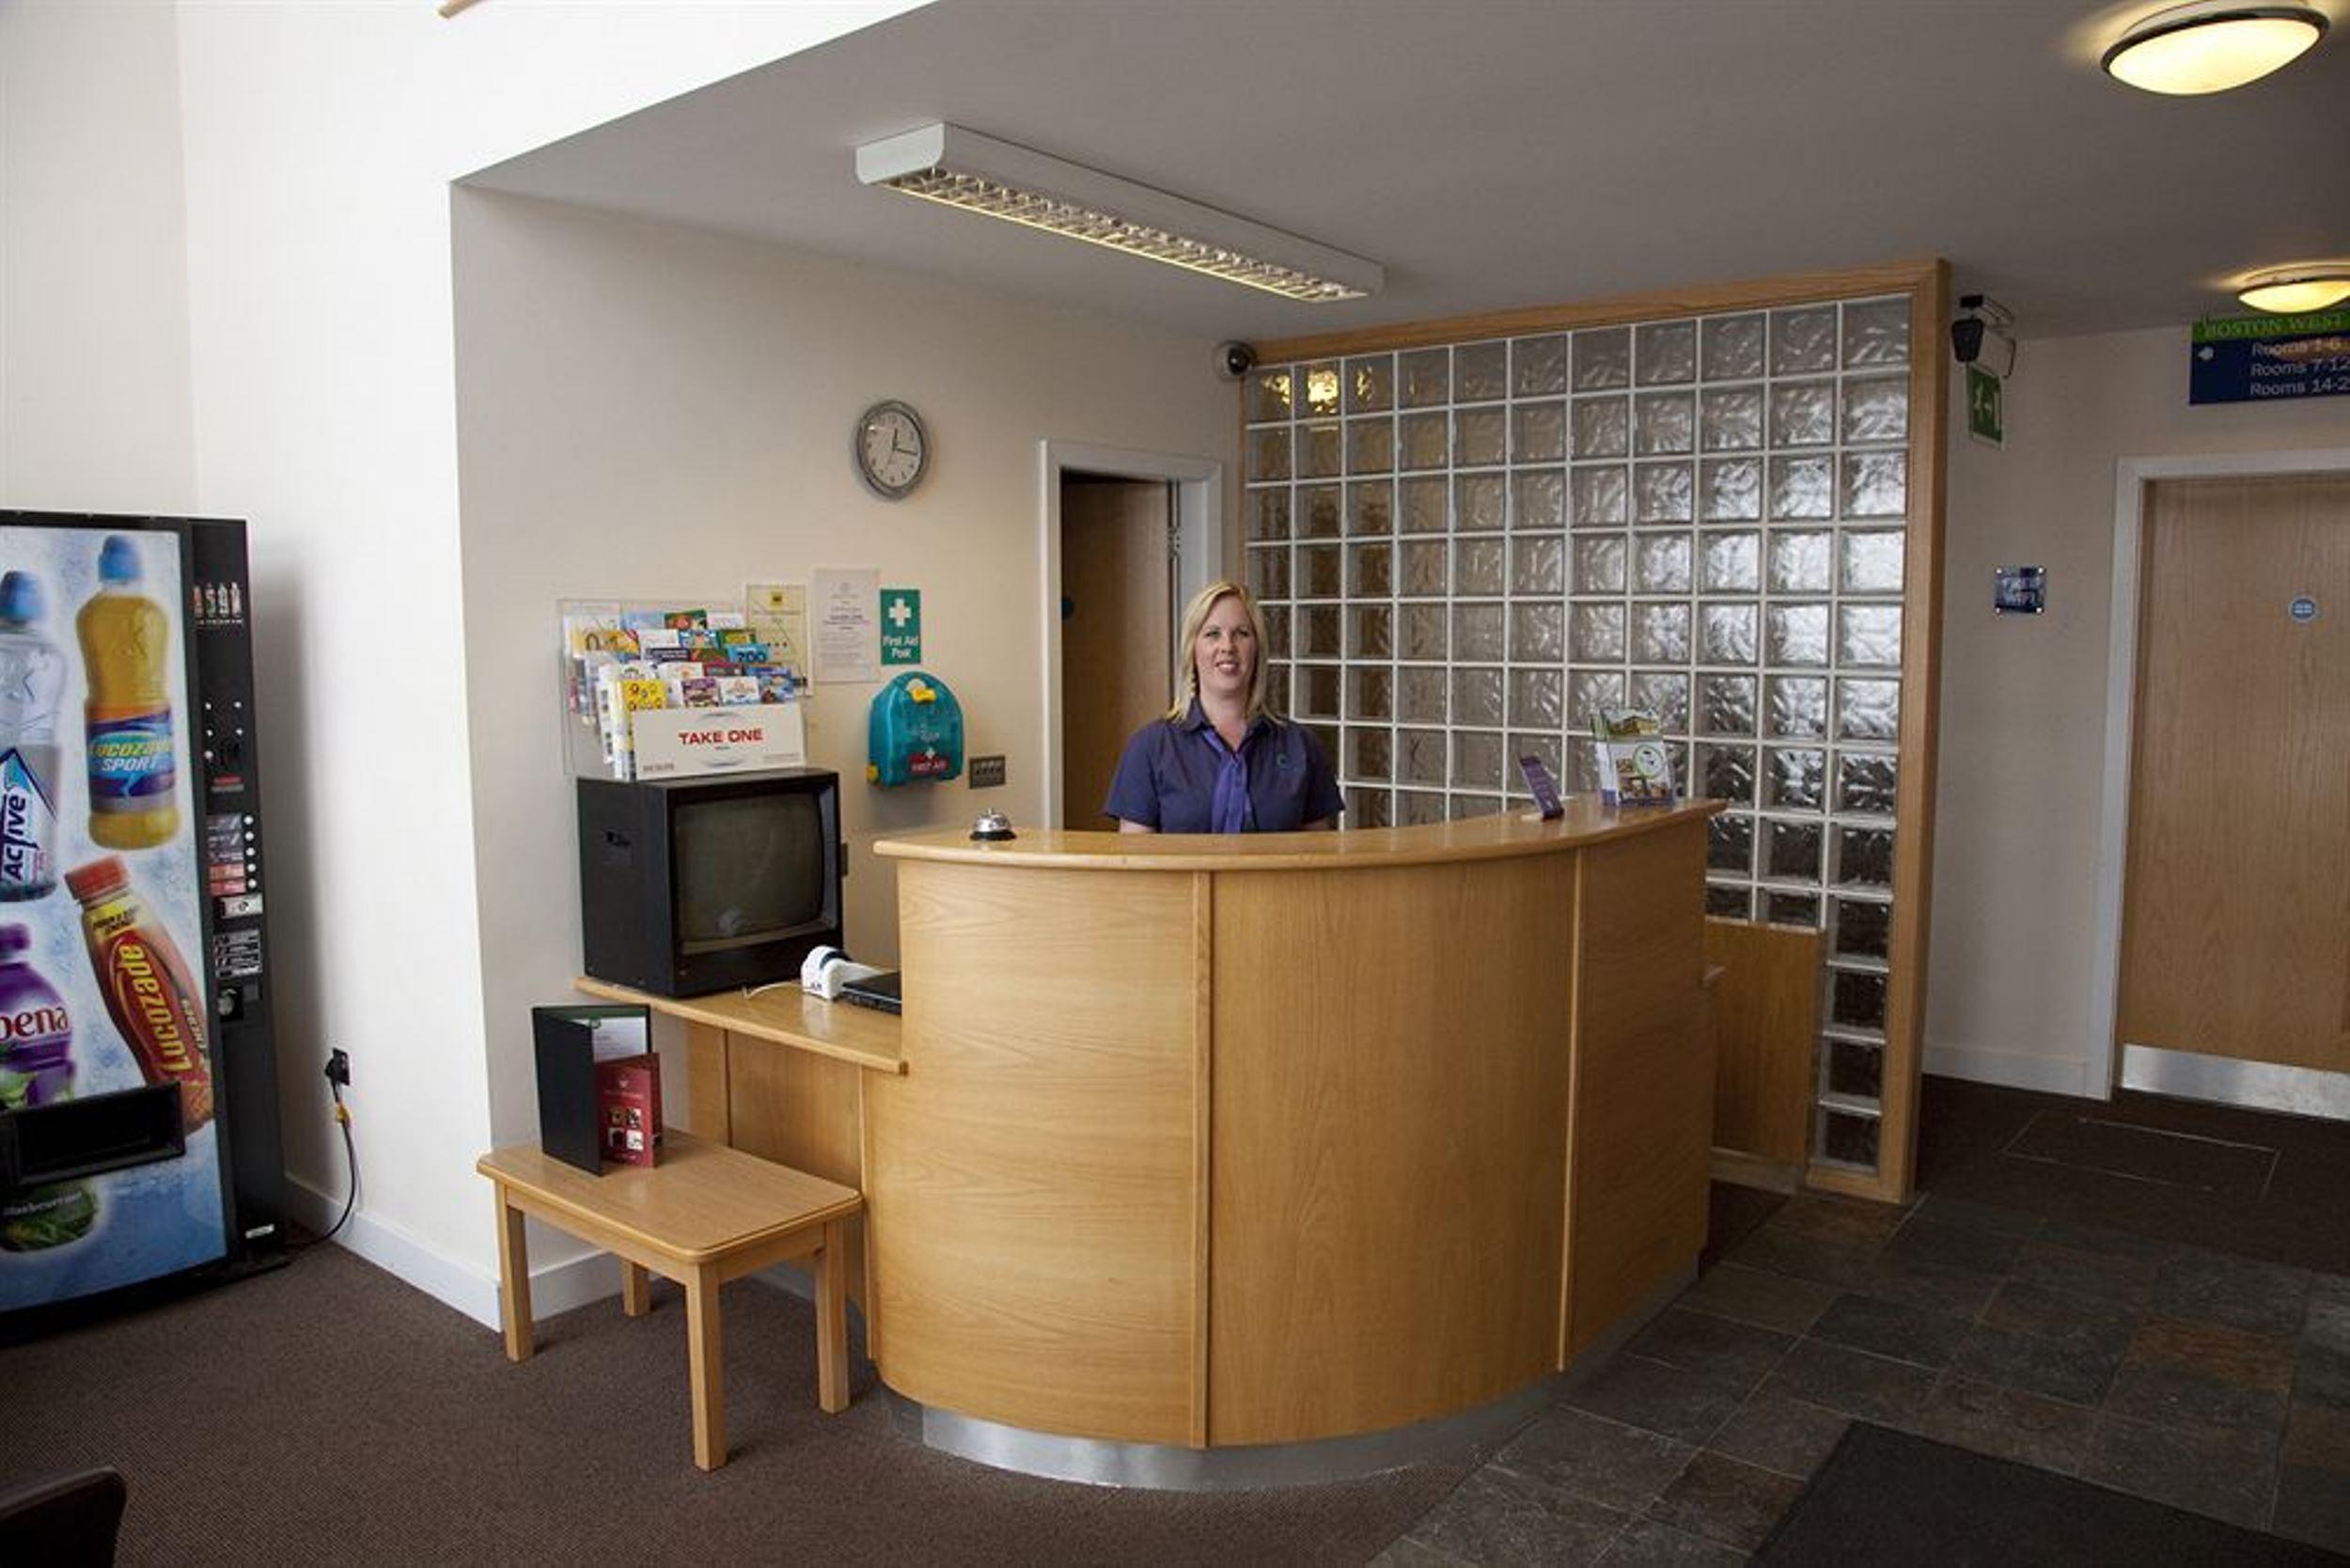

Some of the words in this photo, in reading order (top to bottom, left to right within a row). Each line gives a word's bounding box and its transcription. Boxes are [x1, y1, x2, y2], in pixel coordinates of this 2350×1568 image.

[2251, 340, 2309, 357] Rooms
[2250, 363, 2307, 376] Rooms
[2249, 382, 2306, 395] Rooms
[678, 730, 724, 745] TAKE
[728, 728, 763, 744] ONE
[101, 756, 157, 772] SPORT
[118, 944, 193, 1073] Lucozade
